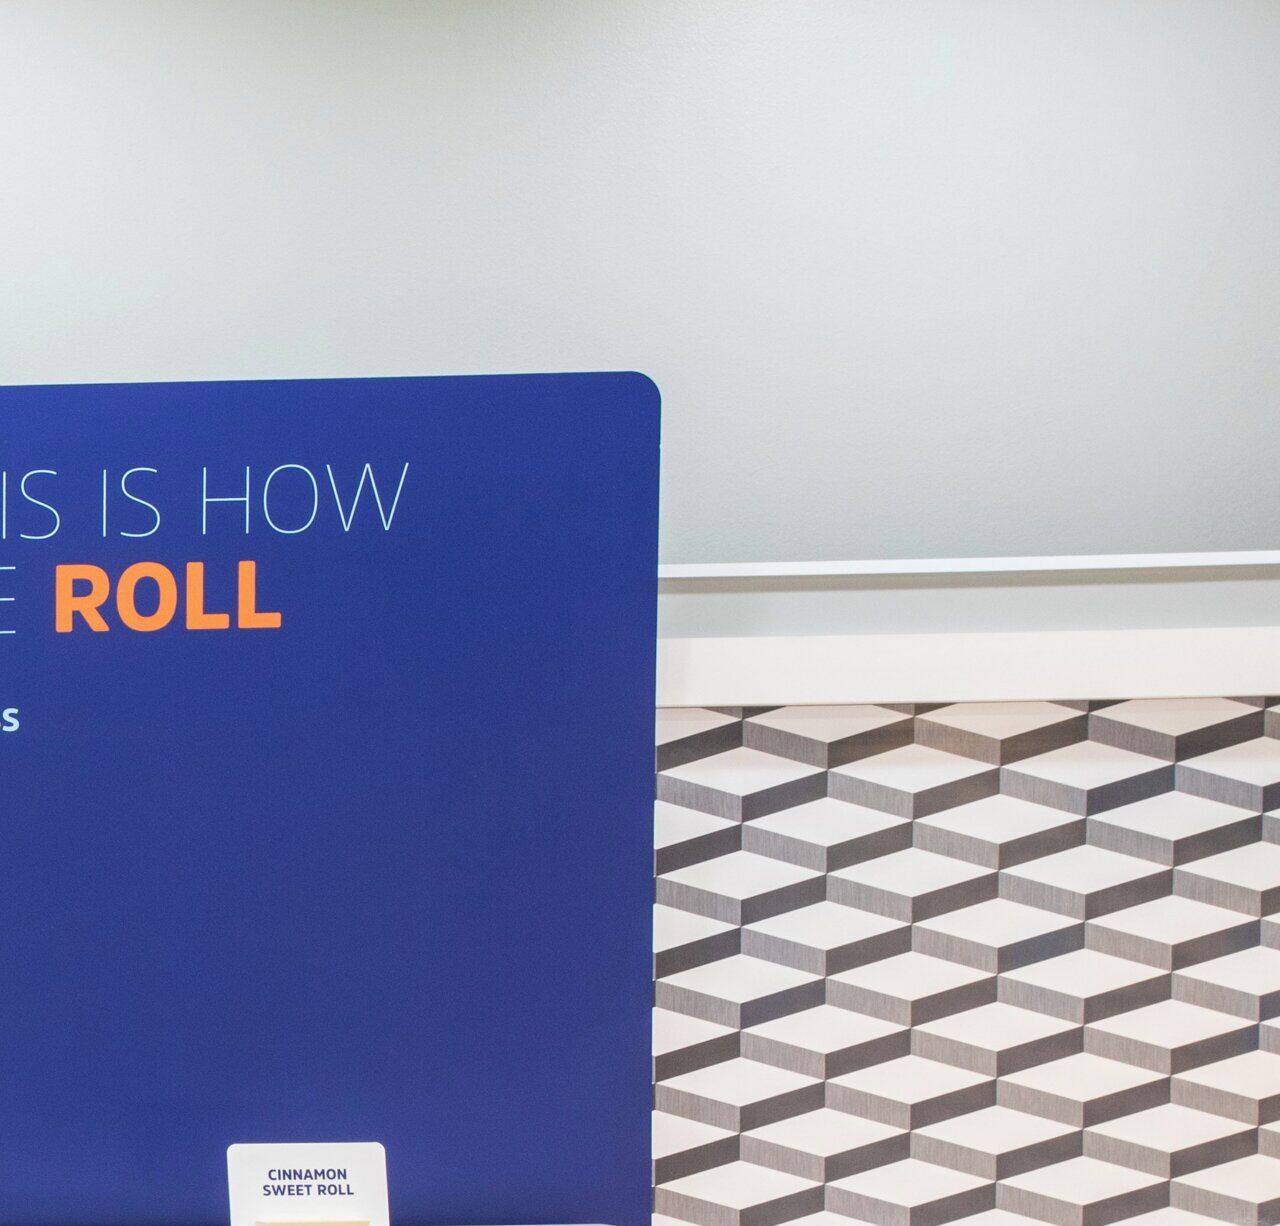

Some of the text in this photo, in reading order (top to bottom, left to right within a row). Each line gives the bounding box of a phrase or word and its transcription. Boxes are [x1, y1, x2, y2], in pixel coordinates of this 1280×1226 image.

[102, 467, 162, 537] IS
[202, 462, 409, 535] HOW
[54, 560, 282, 633] ROLL
[262, 1184, 355, 1196] SWEET ROLL
[267, 1168, 348, 1181] CINNAMON
